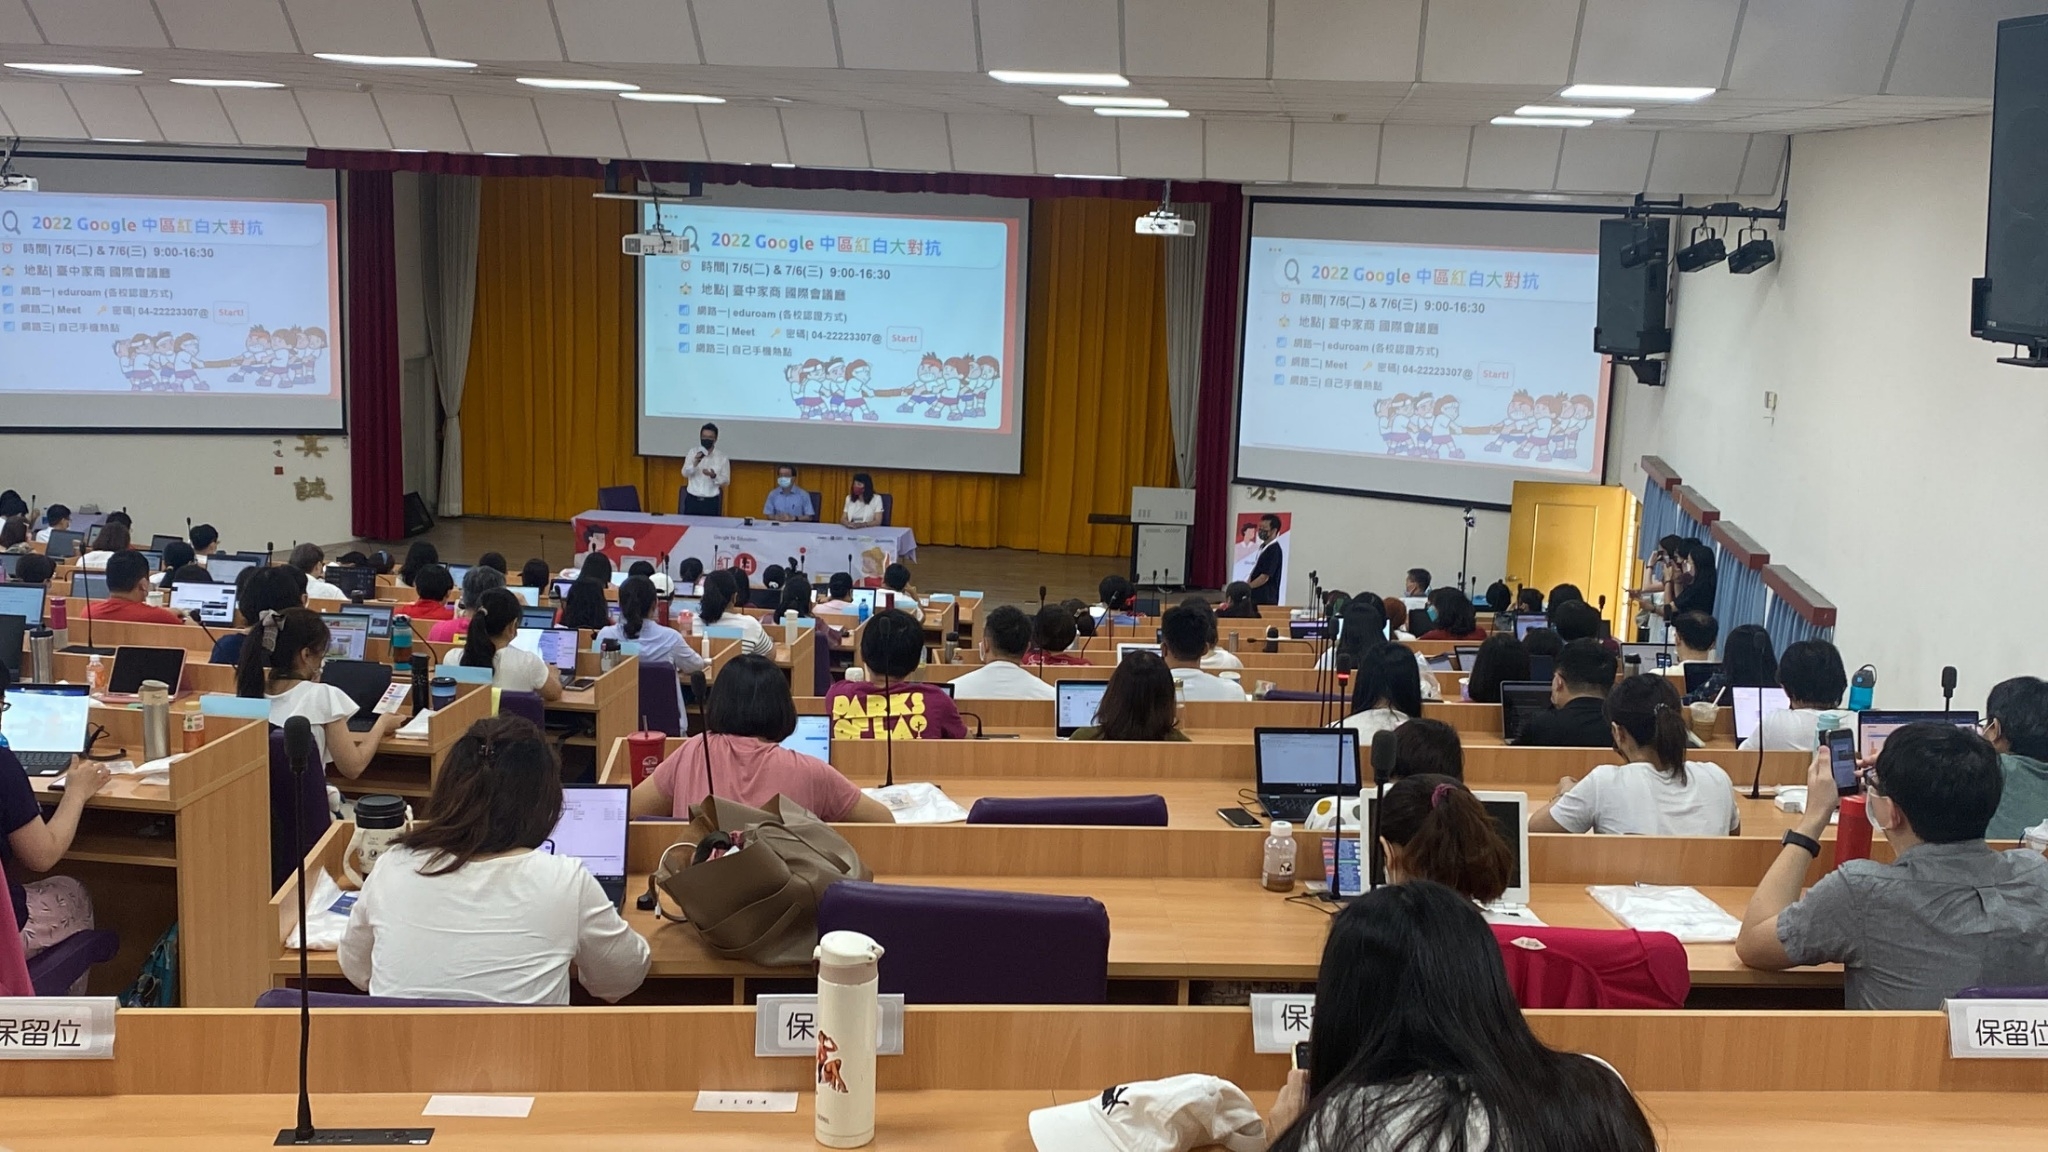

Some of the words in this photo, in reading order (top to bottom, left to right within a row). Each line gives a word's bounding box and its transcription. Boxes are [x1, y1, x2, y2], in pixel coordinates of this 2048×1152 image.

[32, 216, 72, 230] 2022
[77, 217, 137, 234] Google
[711, 232, 751, 248] 2022
[755, 234, 814, 253] Google
[820, 235, 941, 257] 中區紅白大對抗
[97, 246, 106, 256] &
[153, 247, 214, 259] 9:00-16:30
[773, 265, 782, 275] &
[830, 267, 891, 280] 9:00-16:30
[1311, 265, 1349, 281] 2022
[1353, 267, 1411, 286] Google
[57, 288, 102, 298] eduroam
[732, 284, 781, 299] 臺中家商
[785, 286, 846, 301] 國際會議廳
[57, 305, 81, 315] Meet
[218, 308, 244, 317] Start!
[1368, 297, 1377, 308] &
[1424, 300, 1485, 314] 9:00-16:30
[733, 308, 776, 320] eduroam
[779, 309, 847, 324] (各校認證方式)
[732, 326, 755, 336] Meet
[811, 330, 882, 345] 04-22223307@
[891, 332, 917, 343] Start!
[732, 345, 792, 358] 自己手機熱點
[1327, 341, 1369, 353] eduroam
[1325, 359, 1348, 370] Meet
[1482, 368, 1509, 379] Start!
[833, 692, 926, 720] PARKS
[1280, 1003, 1315, 1031] 保
[785, 1012, 817, 1041] 保
